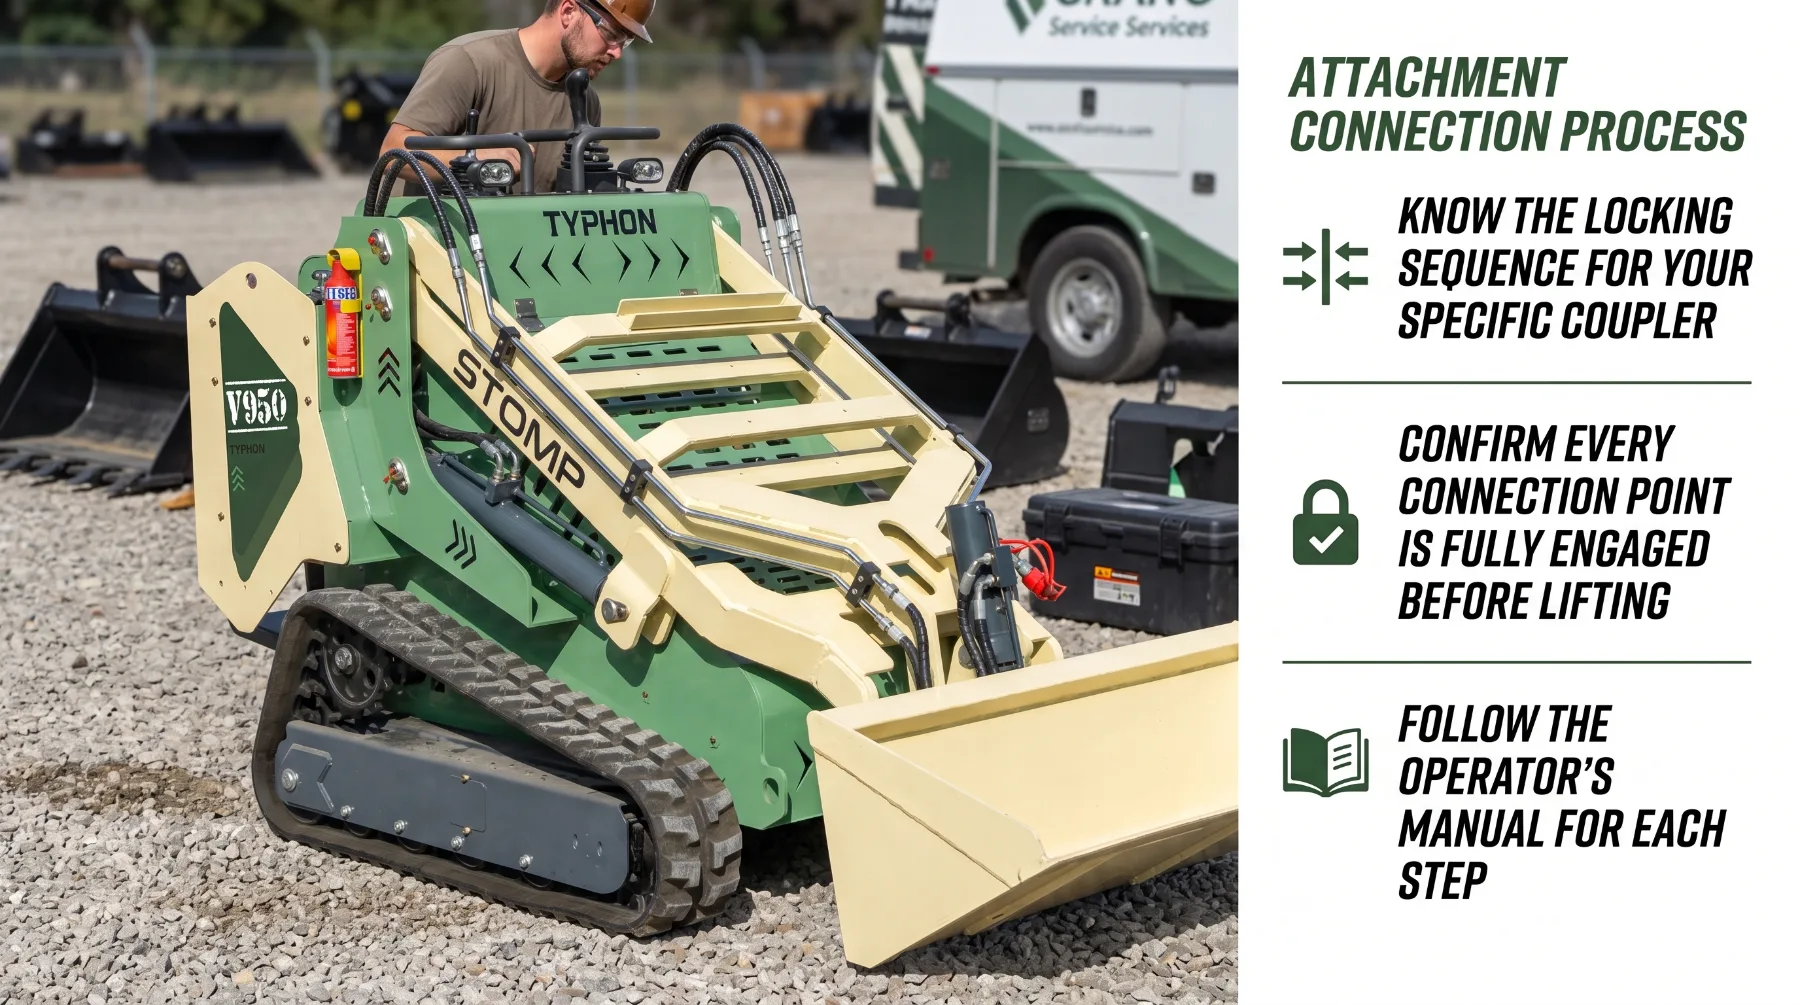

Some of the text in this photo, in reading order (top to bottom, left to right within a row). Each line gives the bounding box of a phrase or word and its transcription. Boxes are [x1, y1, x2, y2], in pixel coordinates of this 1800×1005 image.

[1048, 15, 1209, 37] Service Services
[543, 208, 657, 237] TYPHON
[226, 388, 287, 425] V950
[453, 348, 585, 489] STOMP
[229, 443, 265, 455] TYPHON
